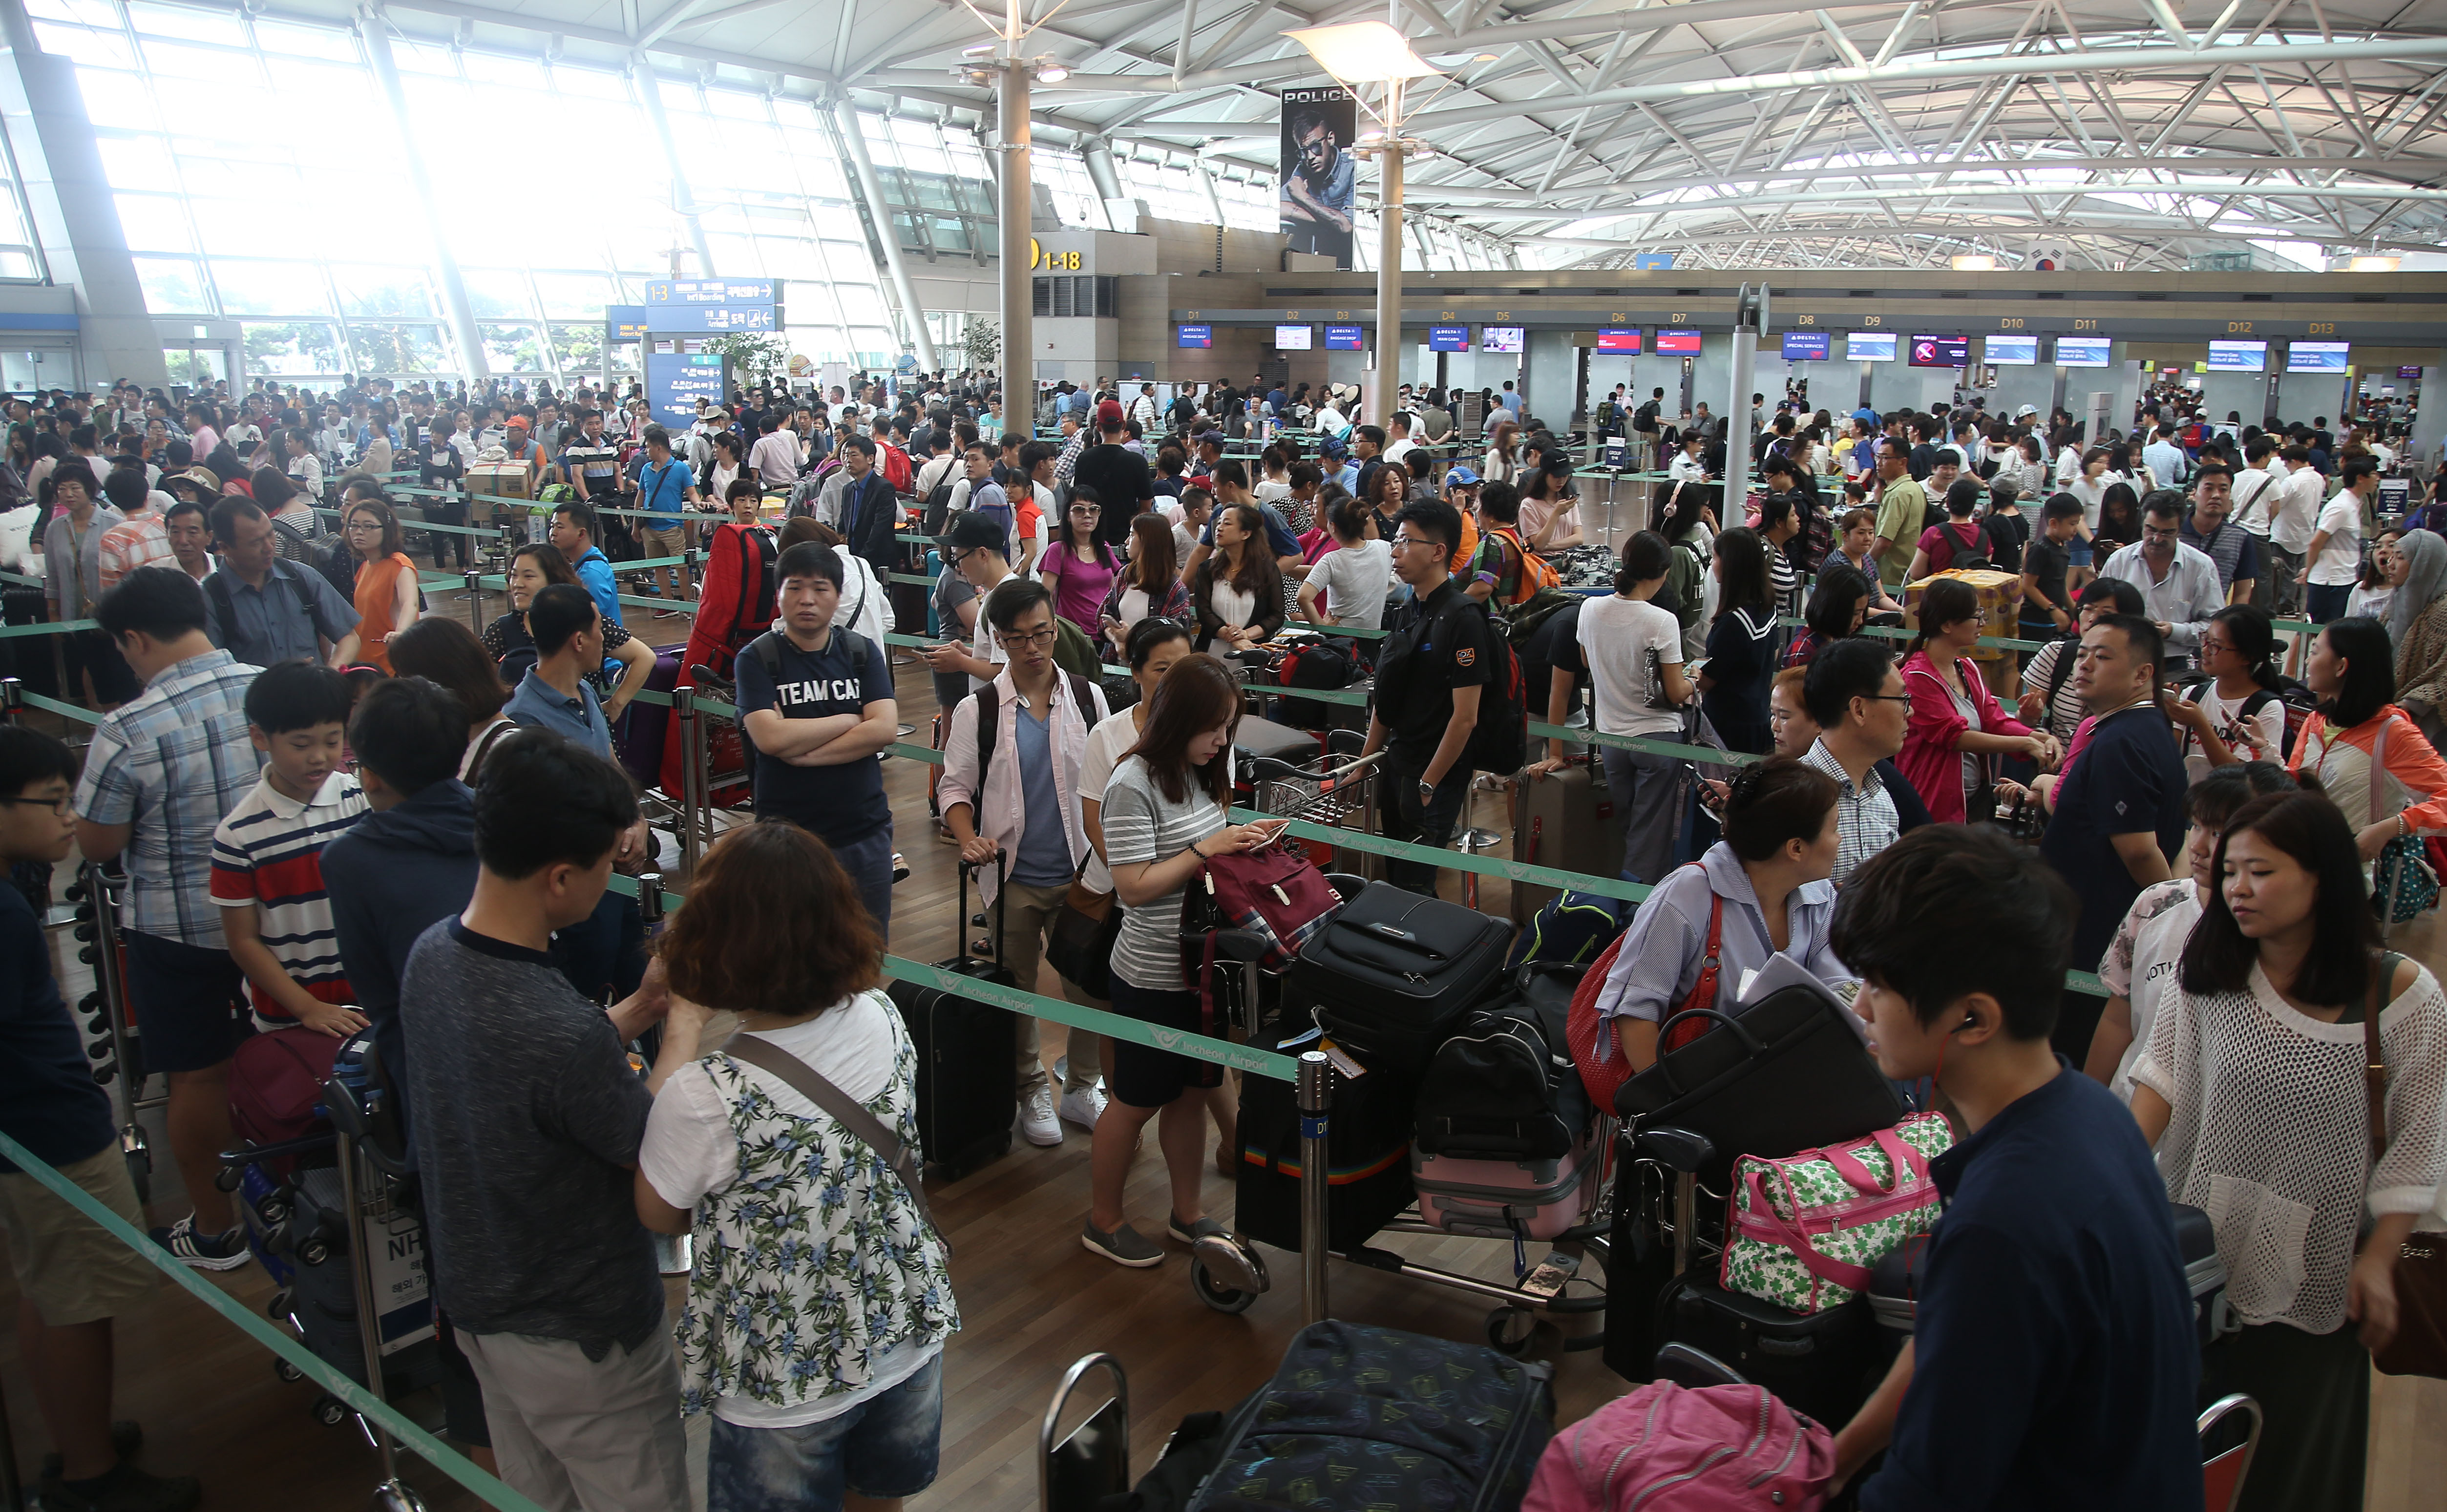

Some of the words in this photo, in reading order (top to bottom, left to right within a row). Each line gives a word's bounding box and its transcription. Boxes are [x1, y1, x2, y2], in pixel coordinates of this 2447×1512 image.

[1284, 89, 1354, 104] POLICE
[1043, 252, 1081, 270] 1-18
[651, 285, 668, 301] 1-3
[699, 293, 725, 303] Boarding
[1337, 312, 1349, 320] D3
[1442, 312, 1455, 320] D4
[1497, 312, 1510, 321] D5
[1612, 313, 1626, 322] D6
[1672, 314, 1687, 322] D7
[1799, 315, 1814, 324] D8
[1865, 316, 1880, 326] D9
[2002, 318, 2024, 329] D10
[2075, 319, 2097, 330] D11
[2228, 321, 2252, 333] D12
[2310, 322, 2334, 334] D13
[776, 680, 829, 706] TEAM
[1594, 737, 1621, 747] Incheon
[1623, 741, 1647, 751] Airport
[1350, 840, 1381, 851] Incheon
[1382, 844, 1410, 857] Airport
[1529, 873, 1562, 885] Incheon
[1565, 878, 1596, 891] Airport
[963, 984, 998, 1002] Incheon
[1000, 995, 1036, 1012] Airport
[1182, 1041, 1225, 1060] Incheon
[1228, 1053, 1268, 1071] Airport
